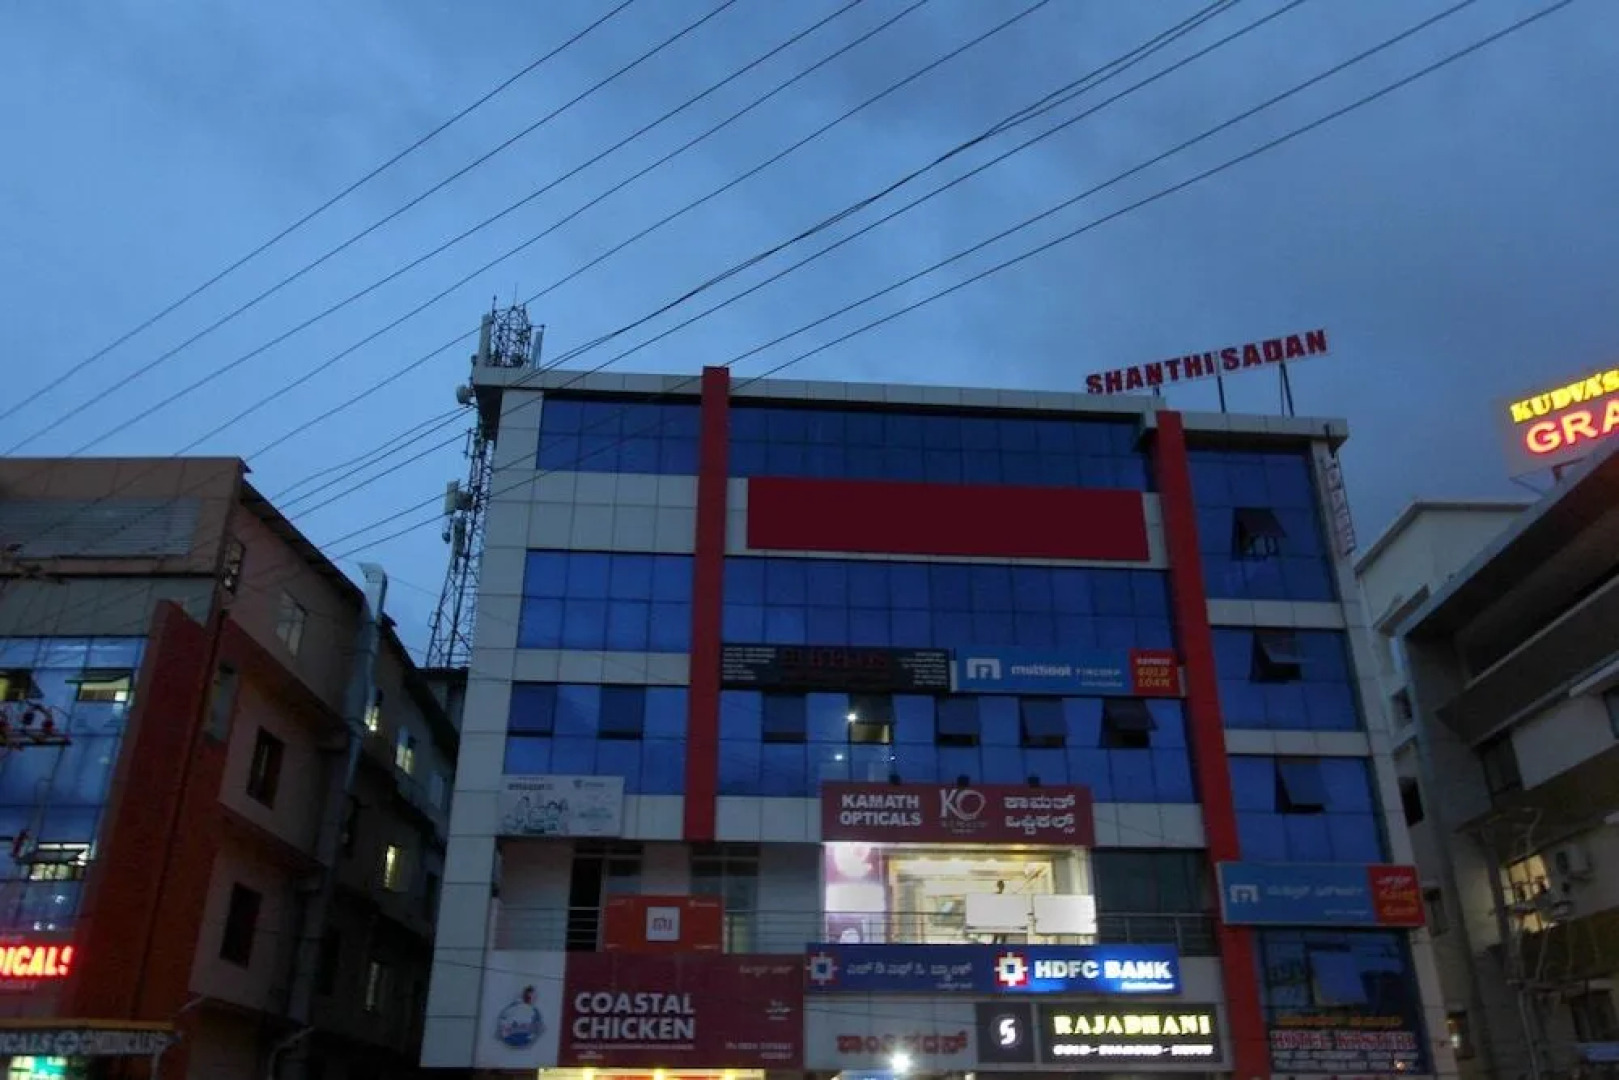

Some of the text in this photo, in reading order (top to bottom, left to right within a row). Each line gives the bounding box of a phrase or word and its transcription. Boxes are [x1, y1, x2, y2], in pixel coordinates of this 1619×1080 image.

[1086, 329, 1327, 394] SHANTHI SADAN
[841, 794, 919, 808] KAMATH
[840, 812, 922, 827] OPTICALS
[1034, 960, 1172, 979] HDFC BANK
[574, 992, 695, 1013] COASTAL
[572, 1016, 695, 1039] CHICKEN
[1054, 1015, 1211, 1034] RAJADHANI
